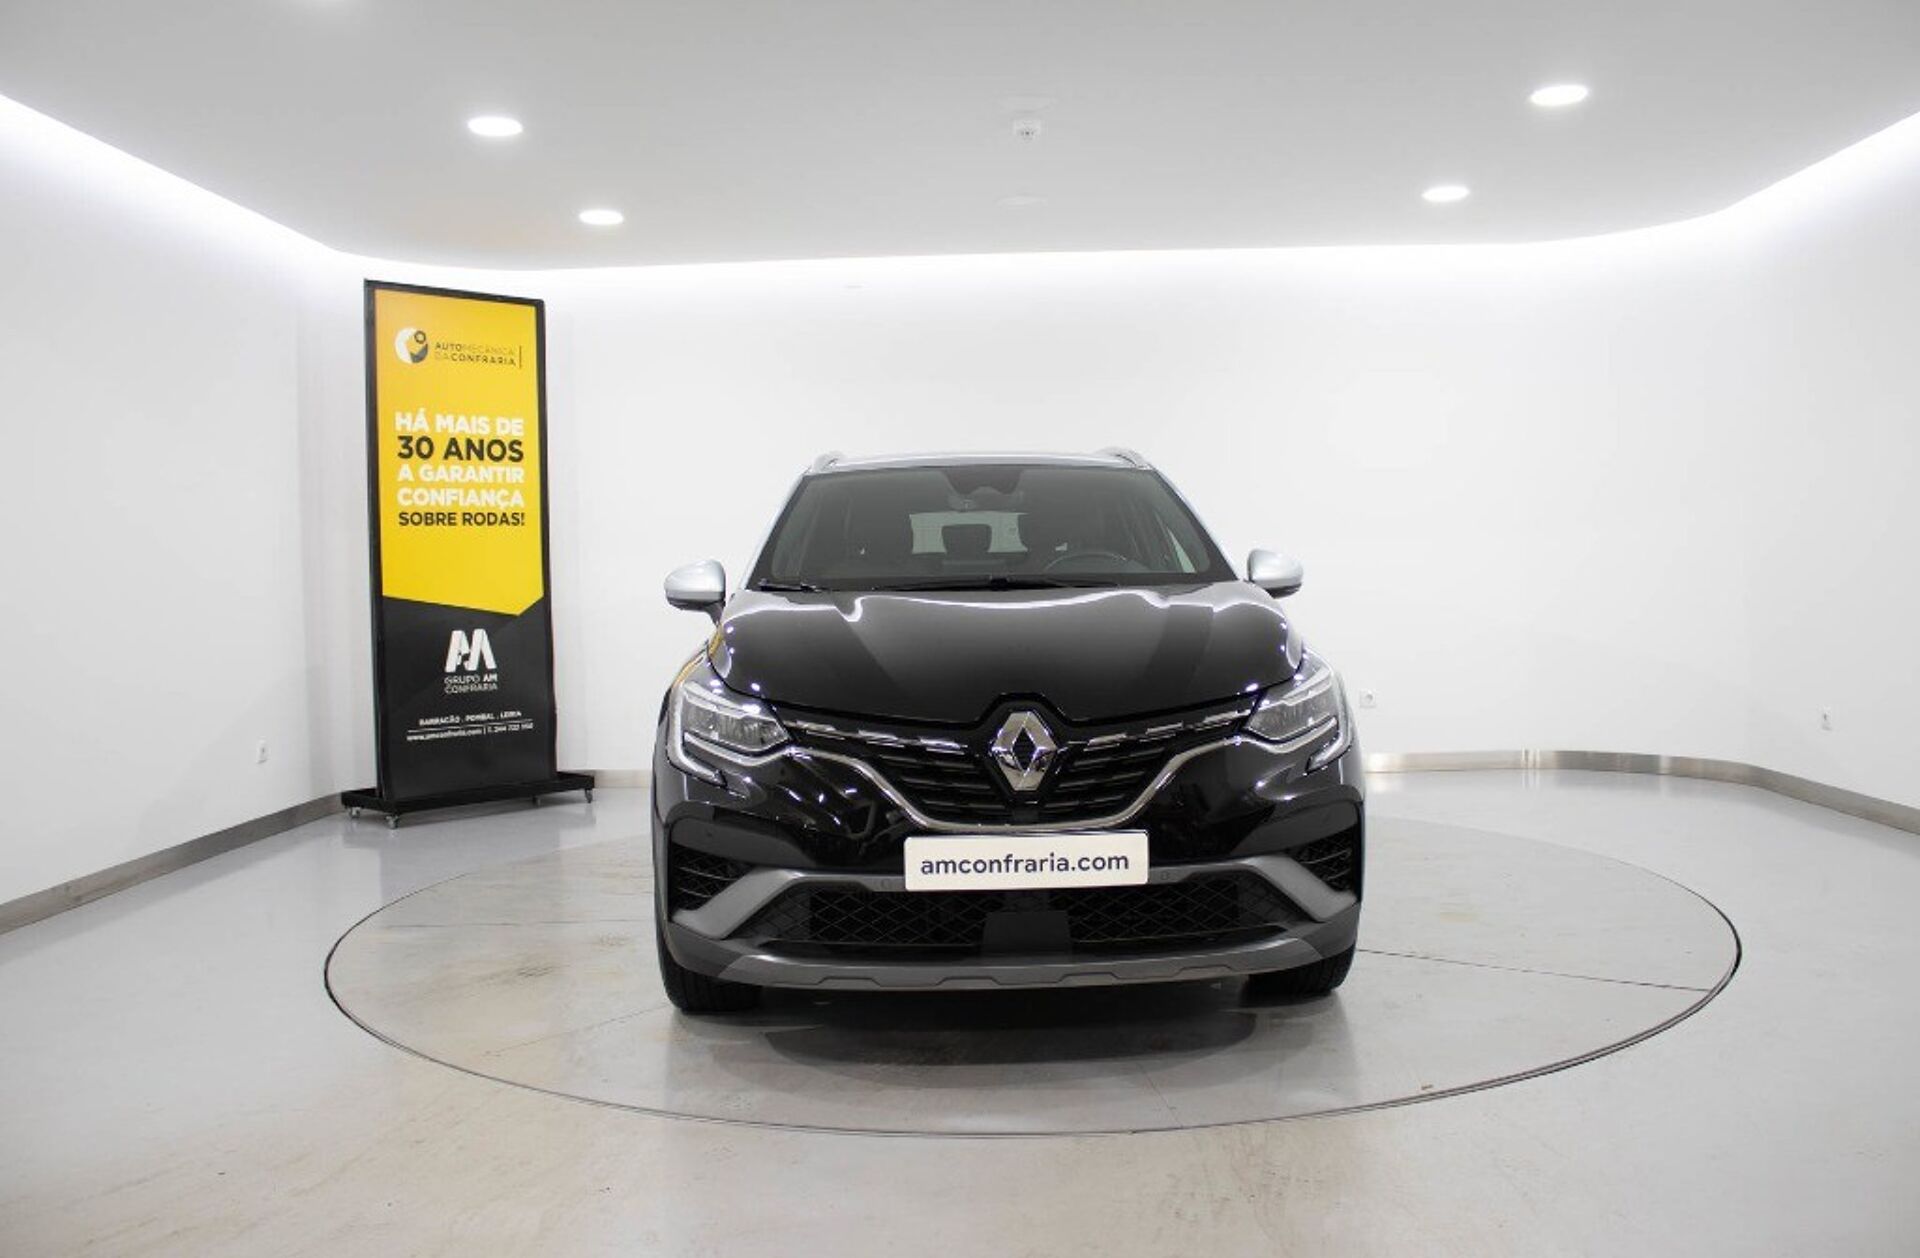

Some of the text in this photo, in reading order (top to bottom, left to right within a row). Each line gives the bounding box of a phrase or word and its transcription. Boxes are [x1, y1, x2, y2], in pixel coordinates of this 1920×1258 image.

[394, 408, 524, 437] HÁ MAIS DE
[397, 435, 524, 463] 30 ANOS
[397, 463, 525, 484] A GARANTIR
[396, 487, 525, 511] CONFIANÇA
[398, 512, 525, 527] SOBRE RODAS!
[443, 673, 498, 685] GRUPO AM
[443, 682, 499, 694] CONFRARIA
[465, 713, 495, 722] POMBAL
[920, 852, 1129, 875] amconfraria.com
